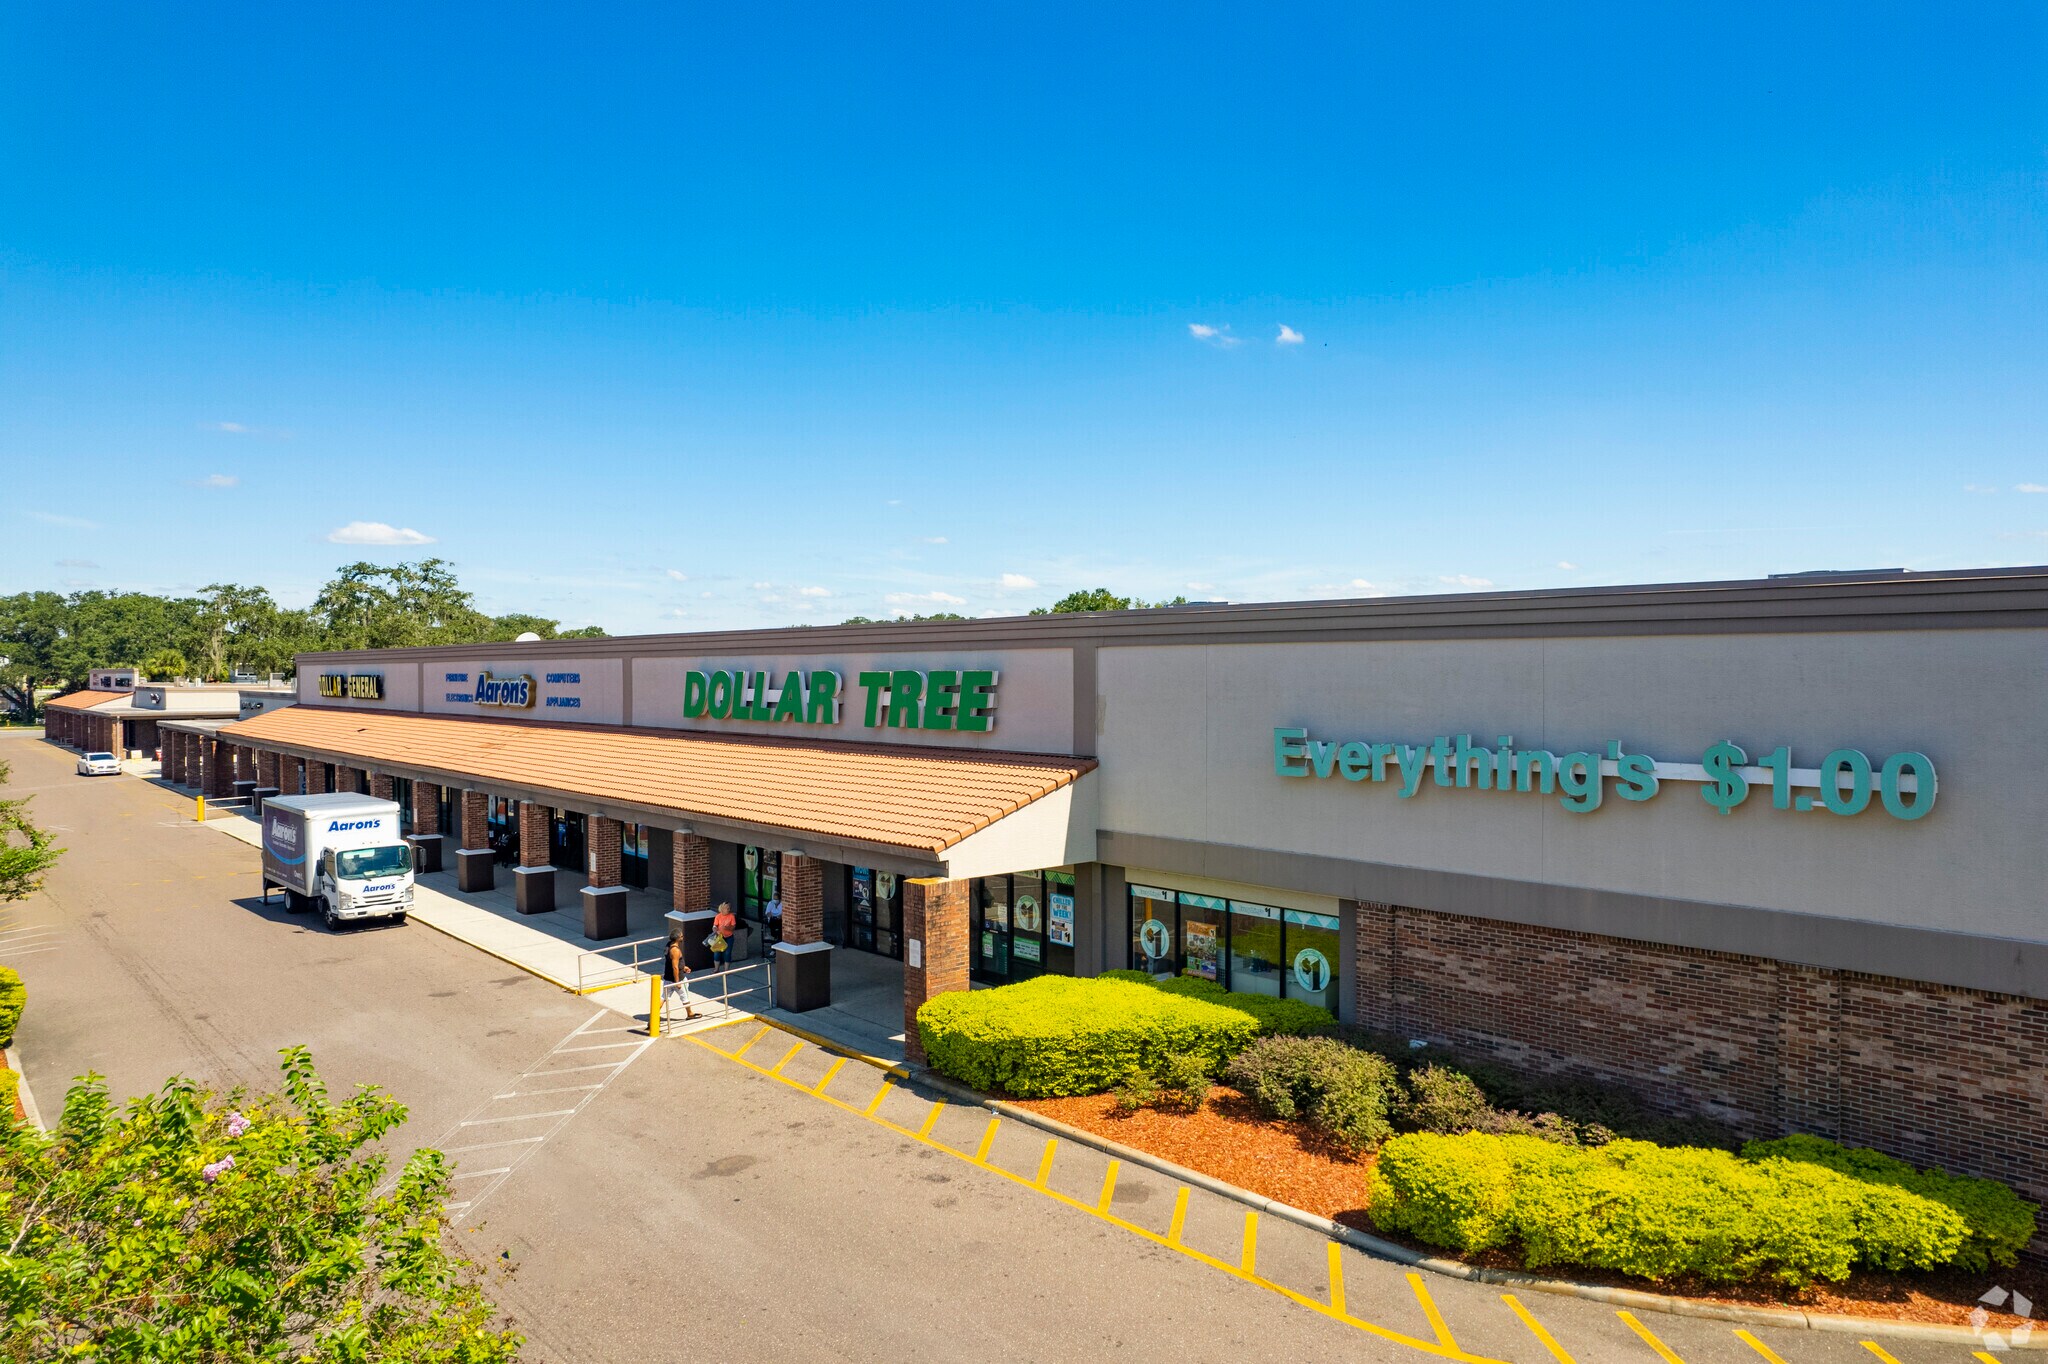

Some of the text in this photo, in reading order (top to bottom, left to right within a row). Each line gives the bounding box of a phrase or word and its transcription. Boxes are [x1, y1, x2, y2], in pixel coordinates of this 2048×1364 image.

[318, 675, 380, 699] DOLLAR GENERAL
[475, 672, 531, 707] Aaron's
[546, 673, 581, 684] COMPUTERS
[683, 669, 998, 732] DOLLAR TREE
[1274, 727, 1938, 820] Everything's $1.00
[271, 816, 297, 845] Aaron's
[328, 818, 381, 832] Aaron's
[363, 883, 395, 893] Aaron's
